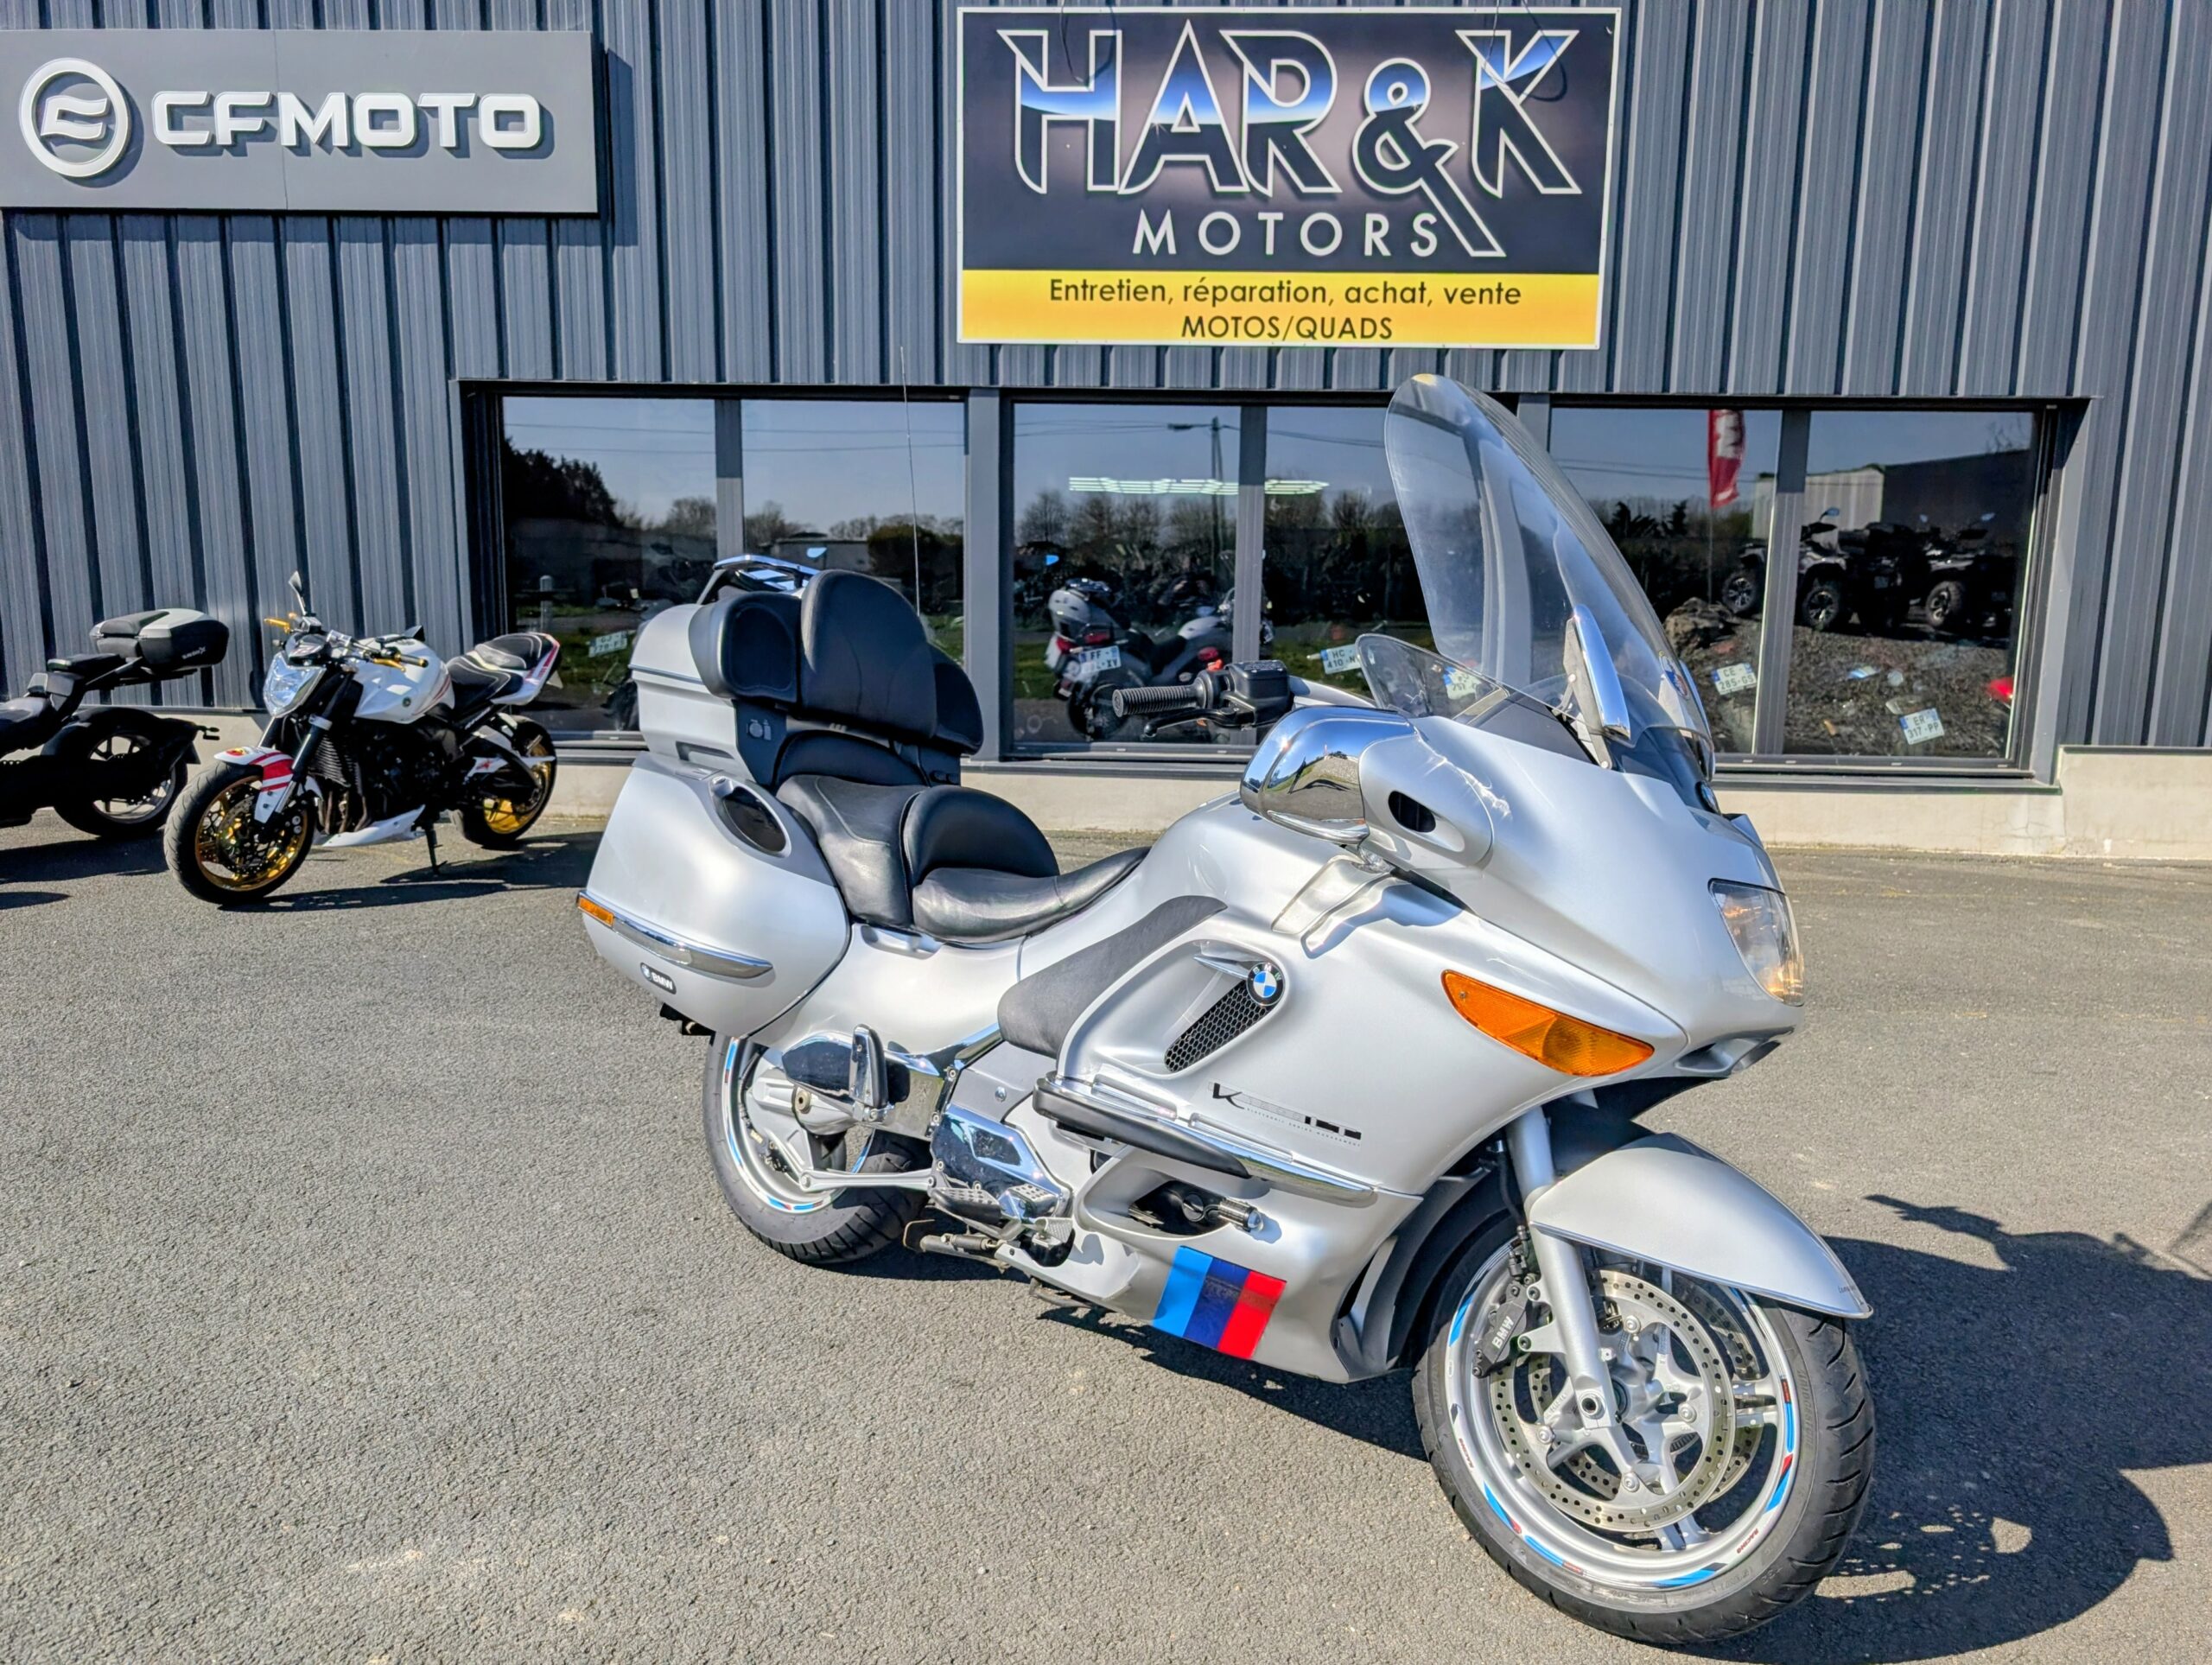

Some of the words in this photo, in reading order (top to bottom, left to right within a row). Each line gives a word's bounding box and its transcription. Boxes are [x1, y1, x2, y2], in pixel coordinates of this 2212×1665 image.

[152, 90, 542, 149] CFMOTO
[1133, 208, 1439, 257] MOTORS
[1050, 278, 1173, 306] Entretien,
[1183, 276, 1334, 308] réparation,
[1344, 281, 1434, 308] achat,
[1444, 282, 1522, 305] vente
[1180, 315, 1393, 340] MOTOS/QUADS
[652, 971, 673, 990] BMW
[1491, 1315, 1514, 1349] BMW
